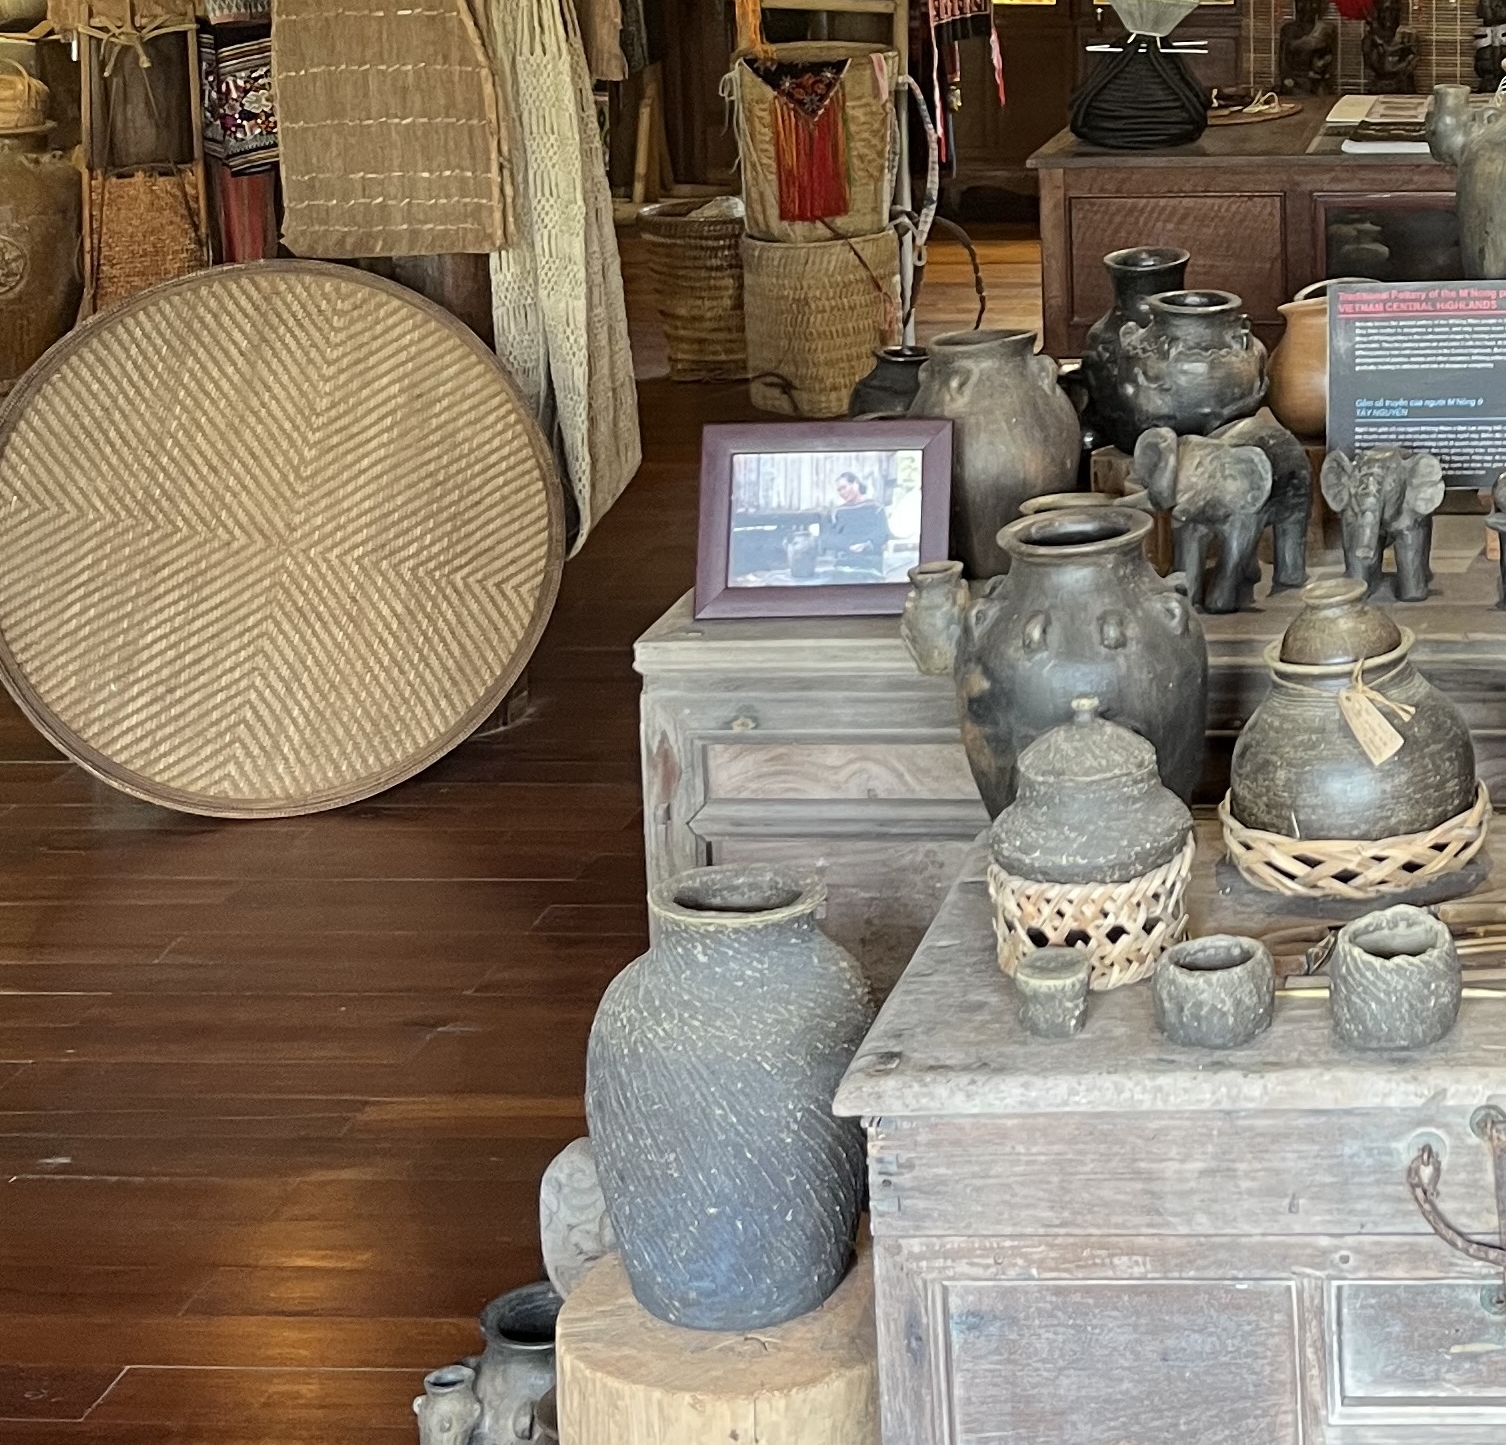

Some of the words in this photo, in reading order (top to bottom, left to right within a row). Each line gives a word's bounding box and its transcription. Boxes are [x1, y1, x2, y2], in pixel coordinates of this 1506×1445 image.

[1391, 289, 1427, 301] Pottery
[1429, 289, 1440, 299] of
[1441, 289, 1457, 298] the
[1338, 303, 1384, 313] VIETNAM
[1385, 302, 1434, 312] CENTRAL
[1437, 300, 1498, 311] HIGHLANDS
